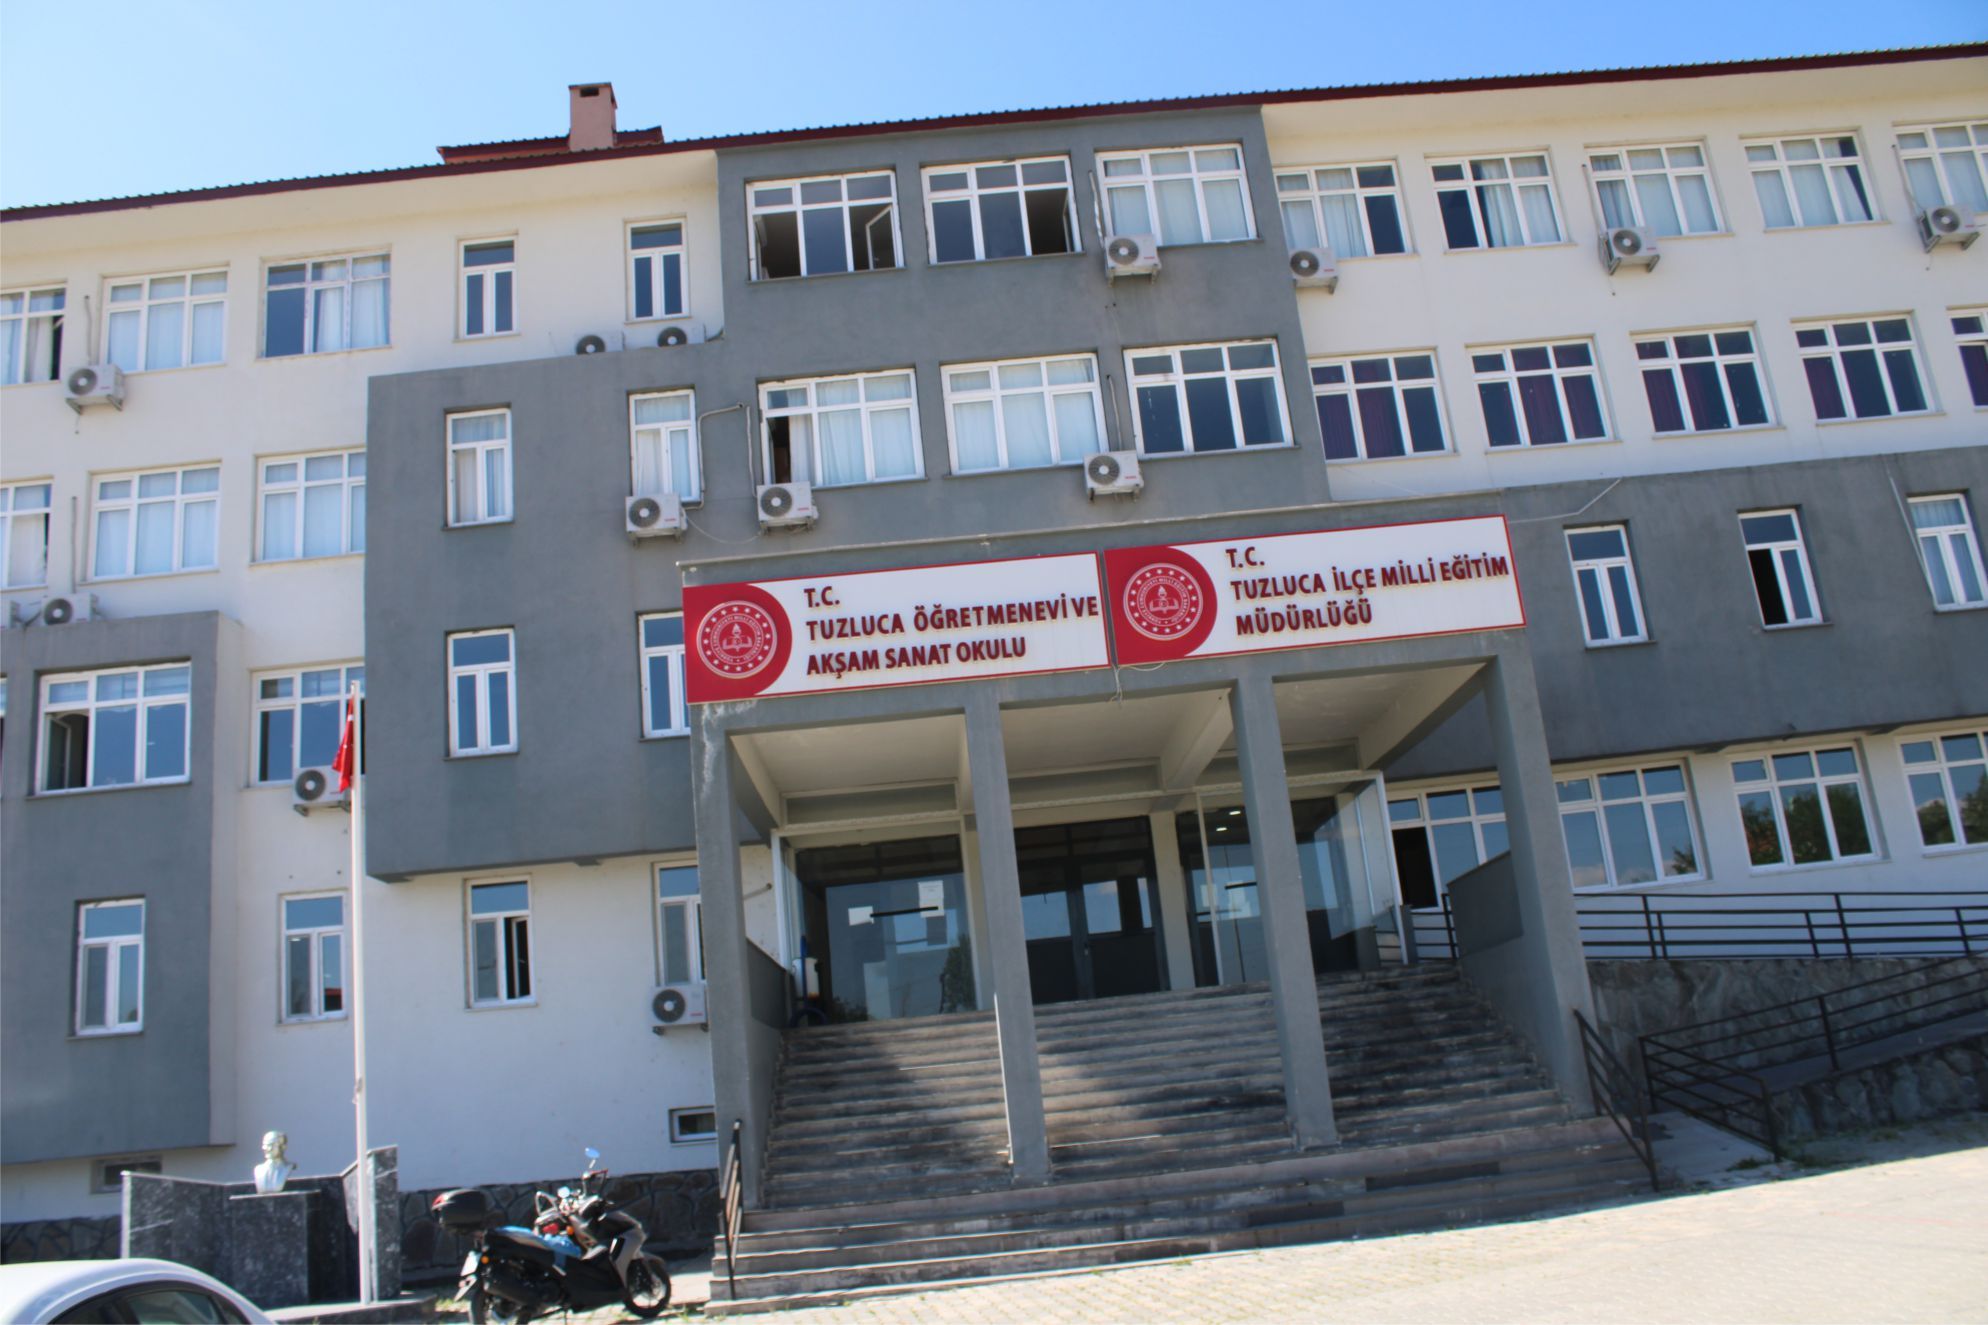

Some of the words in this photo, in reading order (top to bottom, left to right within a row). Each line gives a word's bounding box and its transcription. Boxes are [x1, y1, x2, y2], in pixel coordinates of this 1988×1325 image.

[1226, 546, 1265, 569] T.C.
[1230, 572, 1327, 601] TUZLUCA
[1332, 565, 1377, 596] İLÇE
[1381, 557, 1437, 586] MİLLİ
[1439, 552, 1509, 581] EĞİTİM
[804, 585, 841, 609] T.C.
[806, 613, 905, 641] TUZLUCA
[913, 593, 1068, 632] ÖĞRETMENEVİ
[1070, 595, 1099, 617] VE
[1236, 597, 1373, 636] MÜDÜRLÜĞÜ
[806, 648, 880, 680] AKŞAM
[885, 643, 952, 669] SANAT
[955, 636, 1026, 663] OKULU
